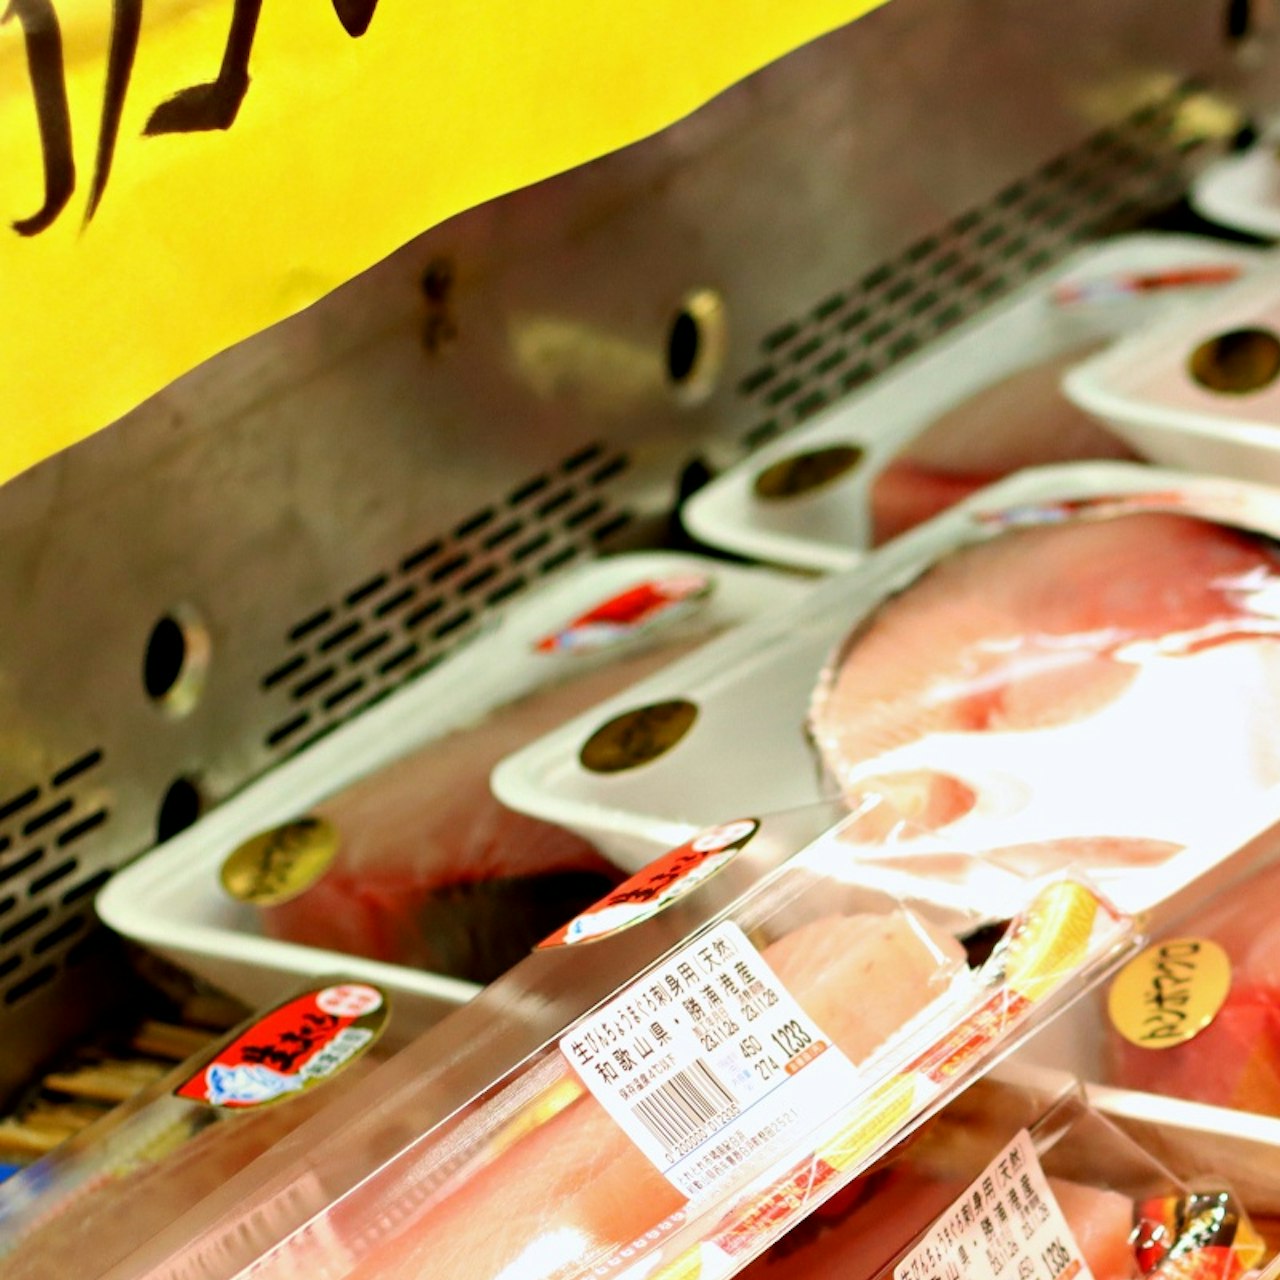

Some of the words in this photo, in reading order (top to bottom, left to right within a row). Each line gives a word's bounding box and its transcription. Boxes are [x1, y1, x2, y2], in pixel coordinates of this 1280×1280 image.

[567, 932, 741, 1065] 生びんちょうまぐろ刺身用(天然)
[1139, 943, 1201, 1041] トンボマグロ
[735, 1033, 764, 1060] 450
[769, 1017, 813, 1059] 1233
[752, 1054, 781, 1081] 274
[1039, 1234, 1071, 1280] 1336
